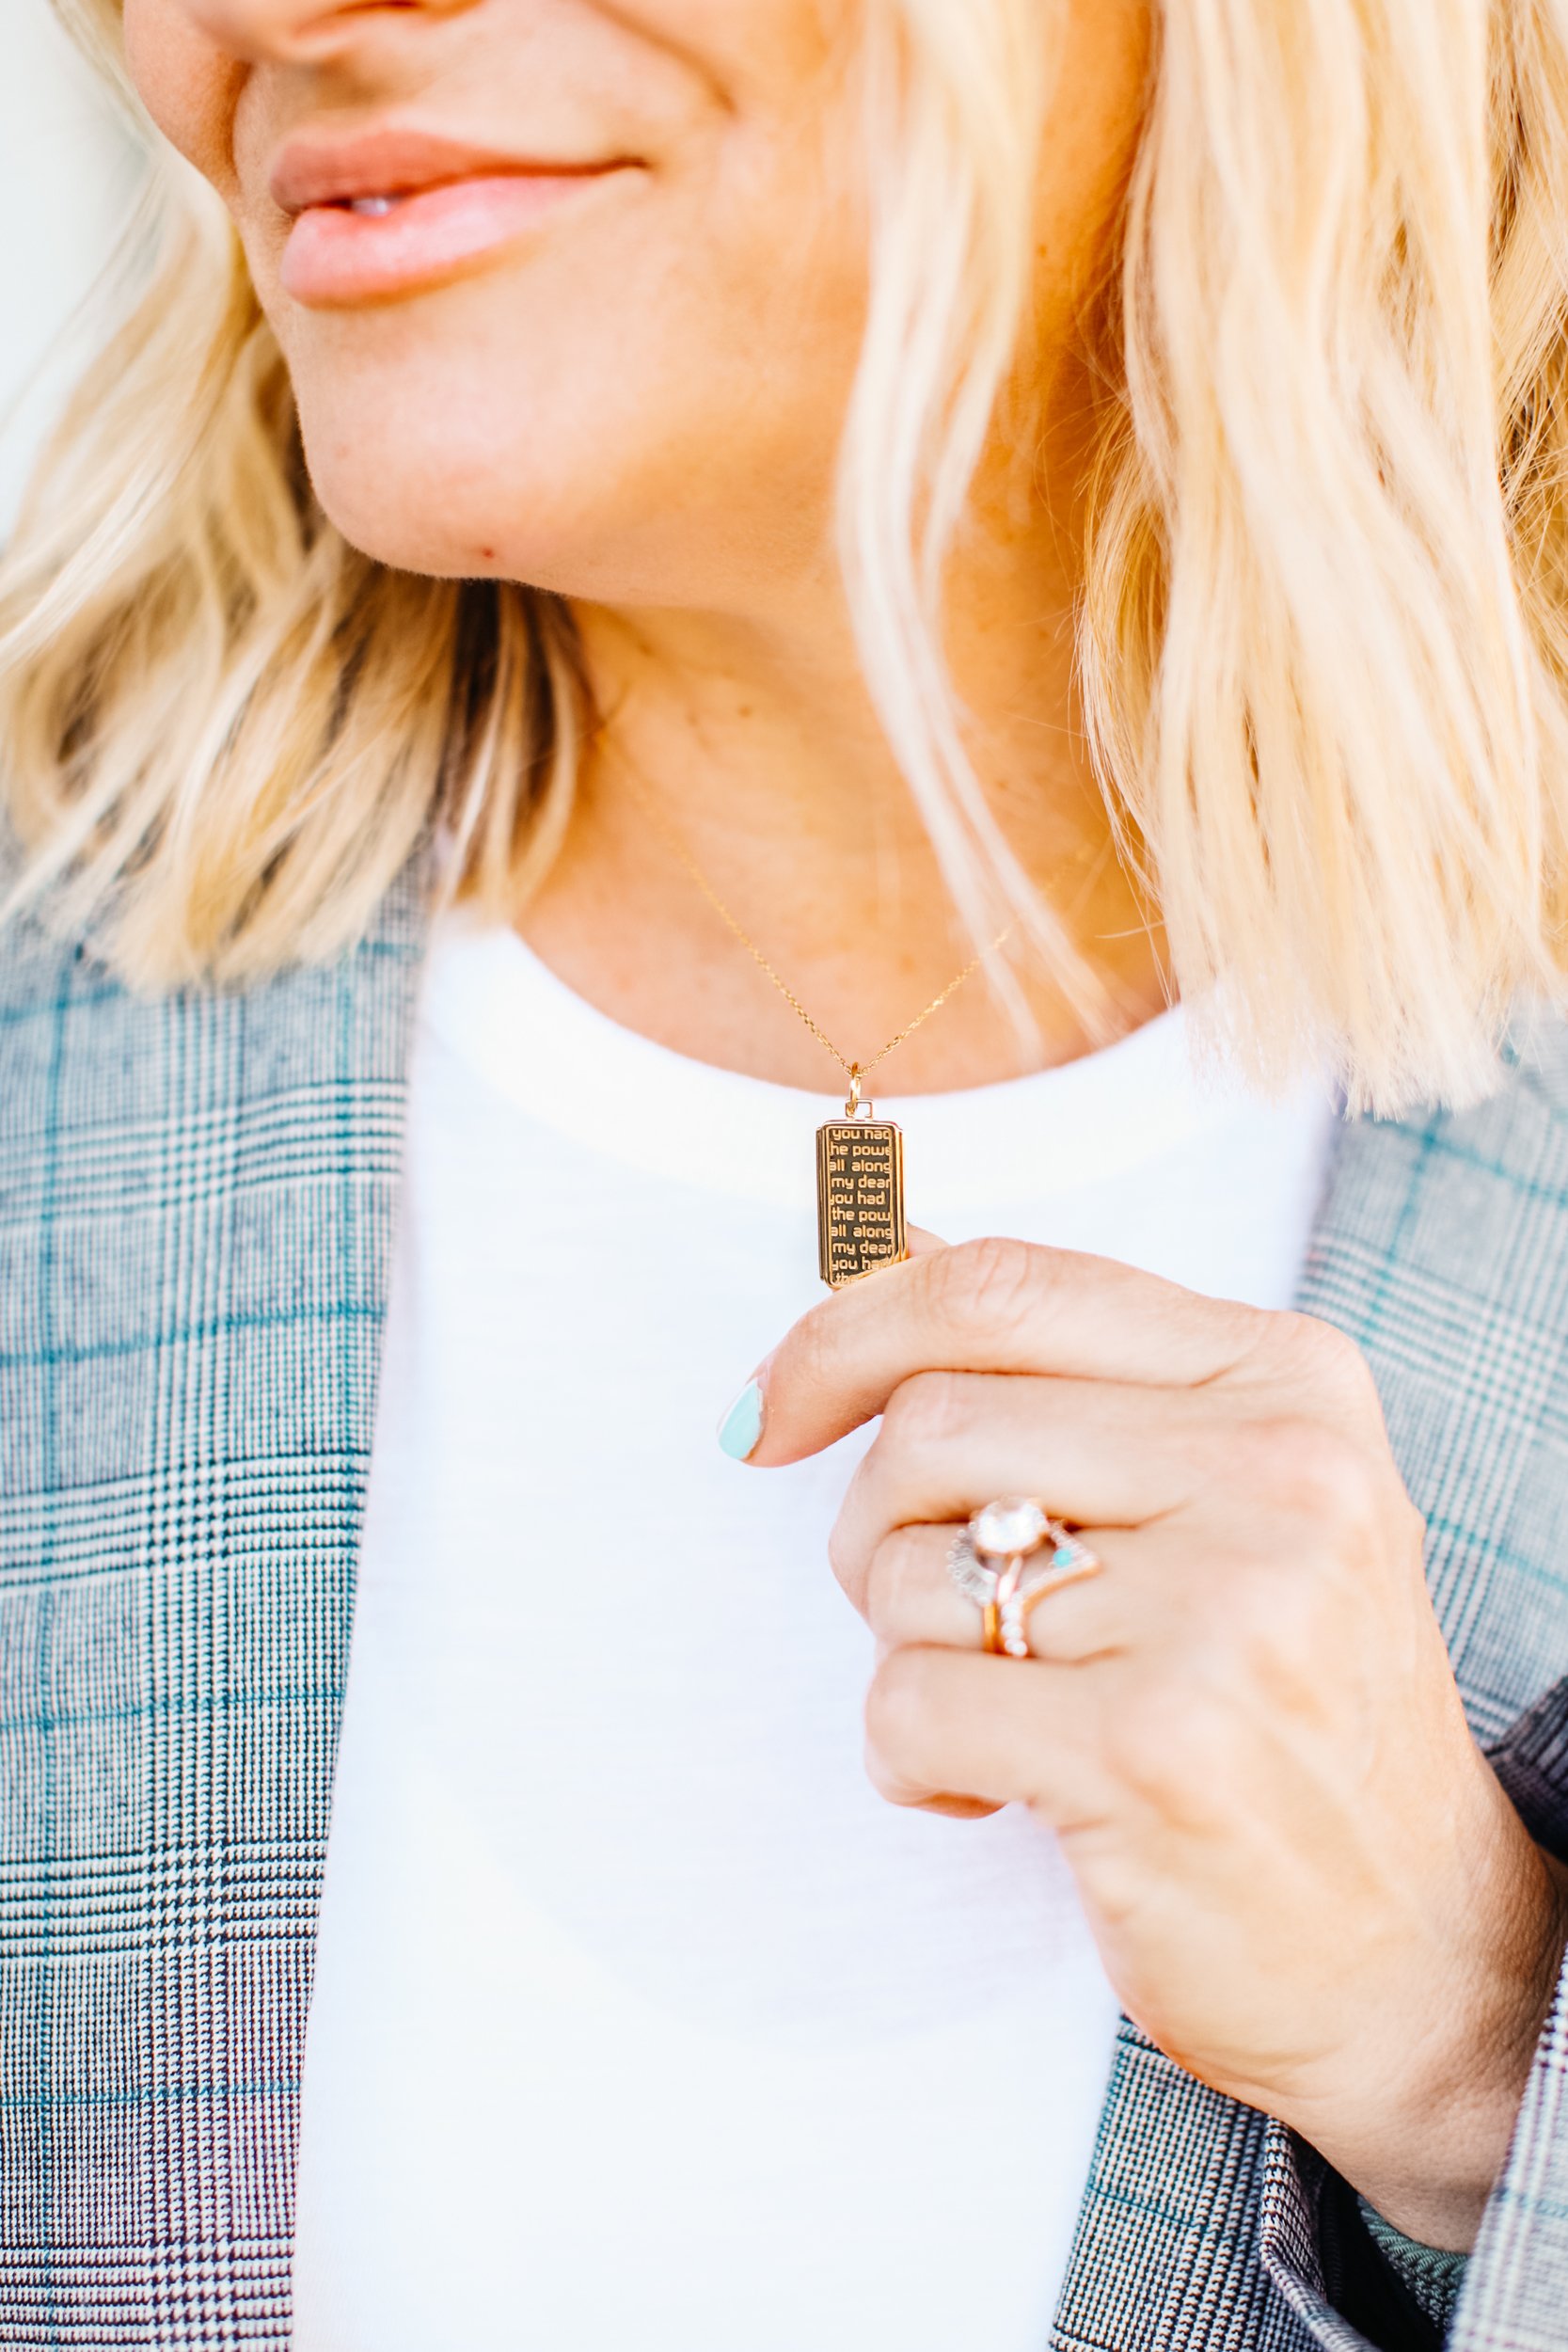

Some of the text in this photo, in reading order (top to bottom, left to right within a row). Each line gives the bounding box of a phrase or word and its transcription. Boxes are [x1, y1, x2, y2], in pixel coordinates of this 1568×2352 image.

[832, 1129, 860, 1141] you
[830, 1140, 848, 1155] he
[829, 1158, 891, 1174] all along
[831, 1173, 891, 1190] my dear
[829, 1189, 885, 1205] you had
[832, 1205, 891, 1223] the pow
[831, 1223, 894, 1240] all along
[832, 1239, 893, 1255] my dear
[832, 1259, 858, 1271] you
